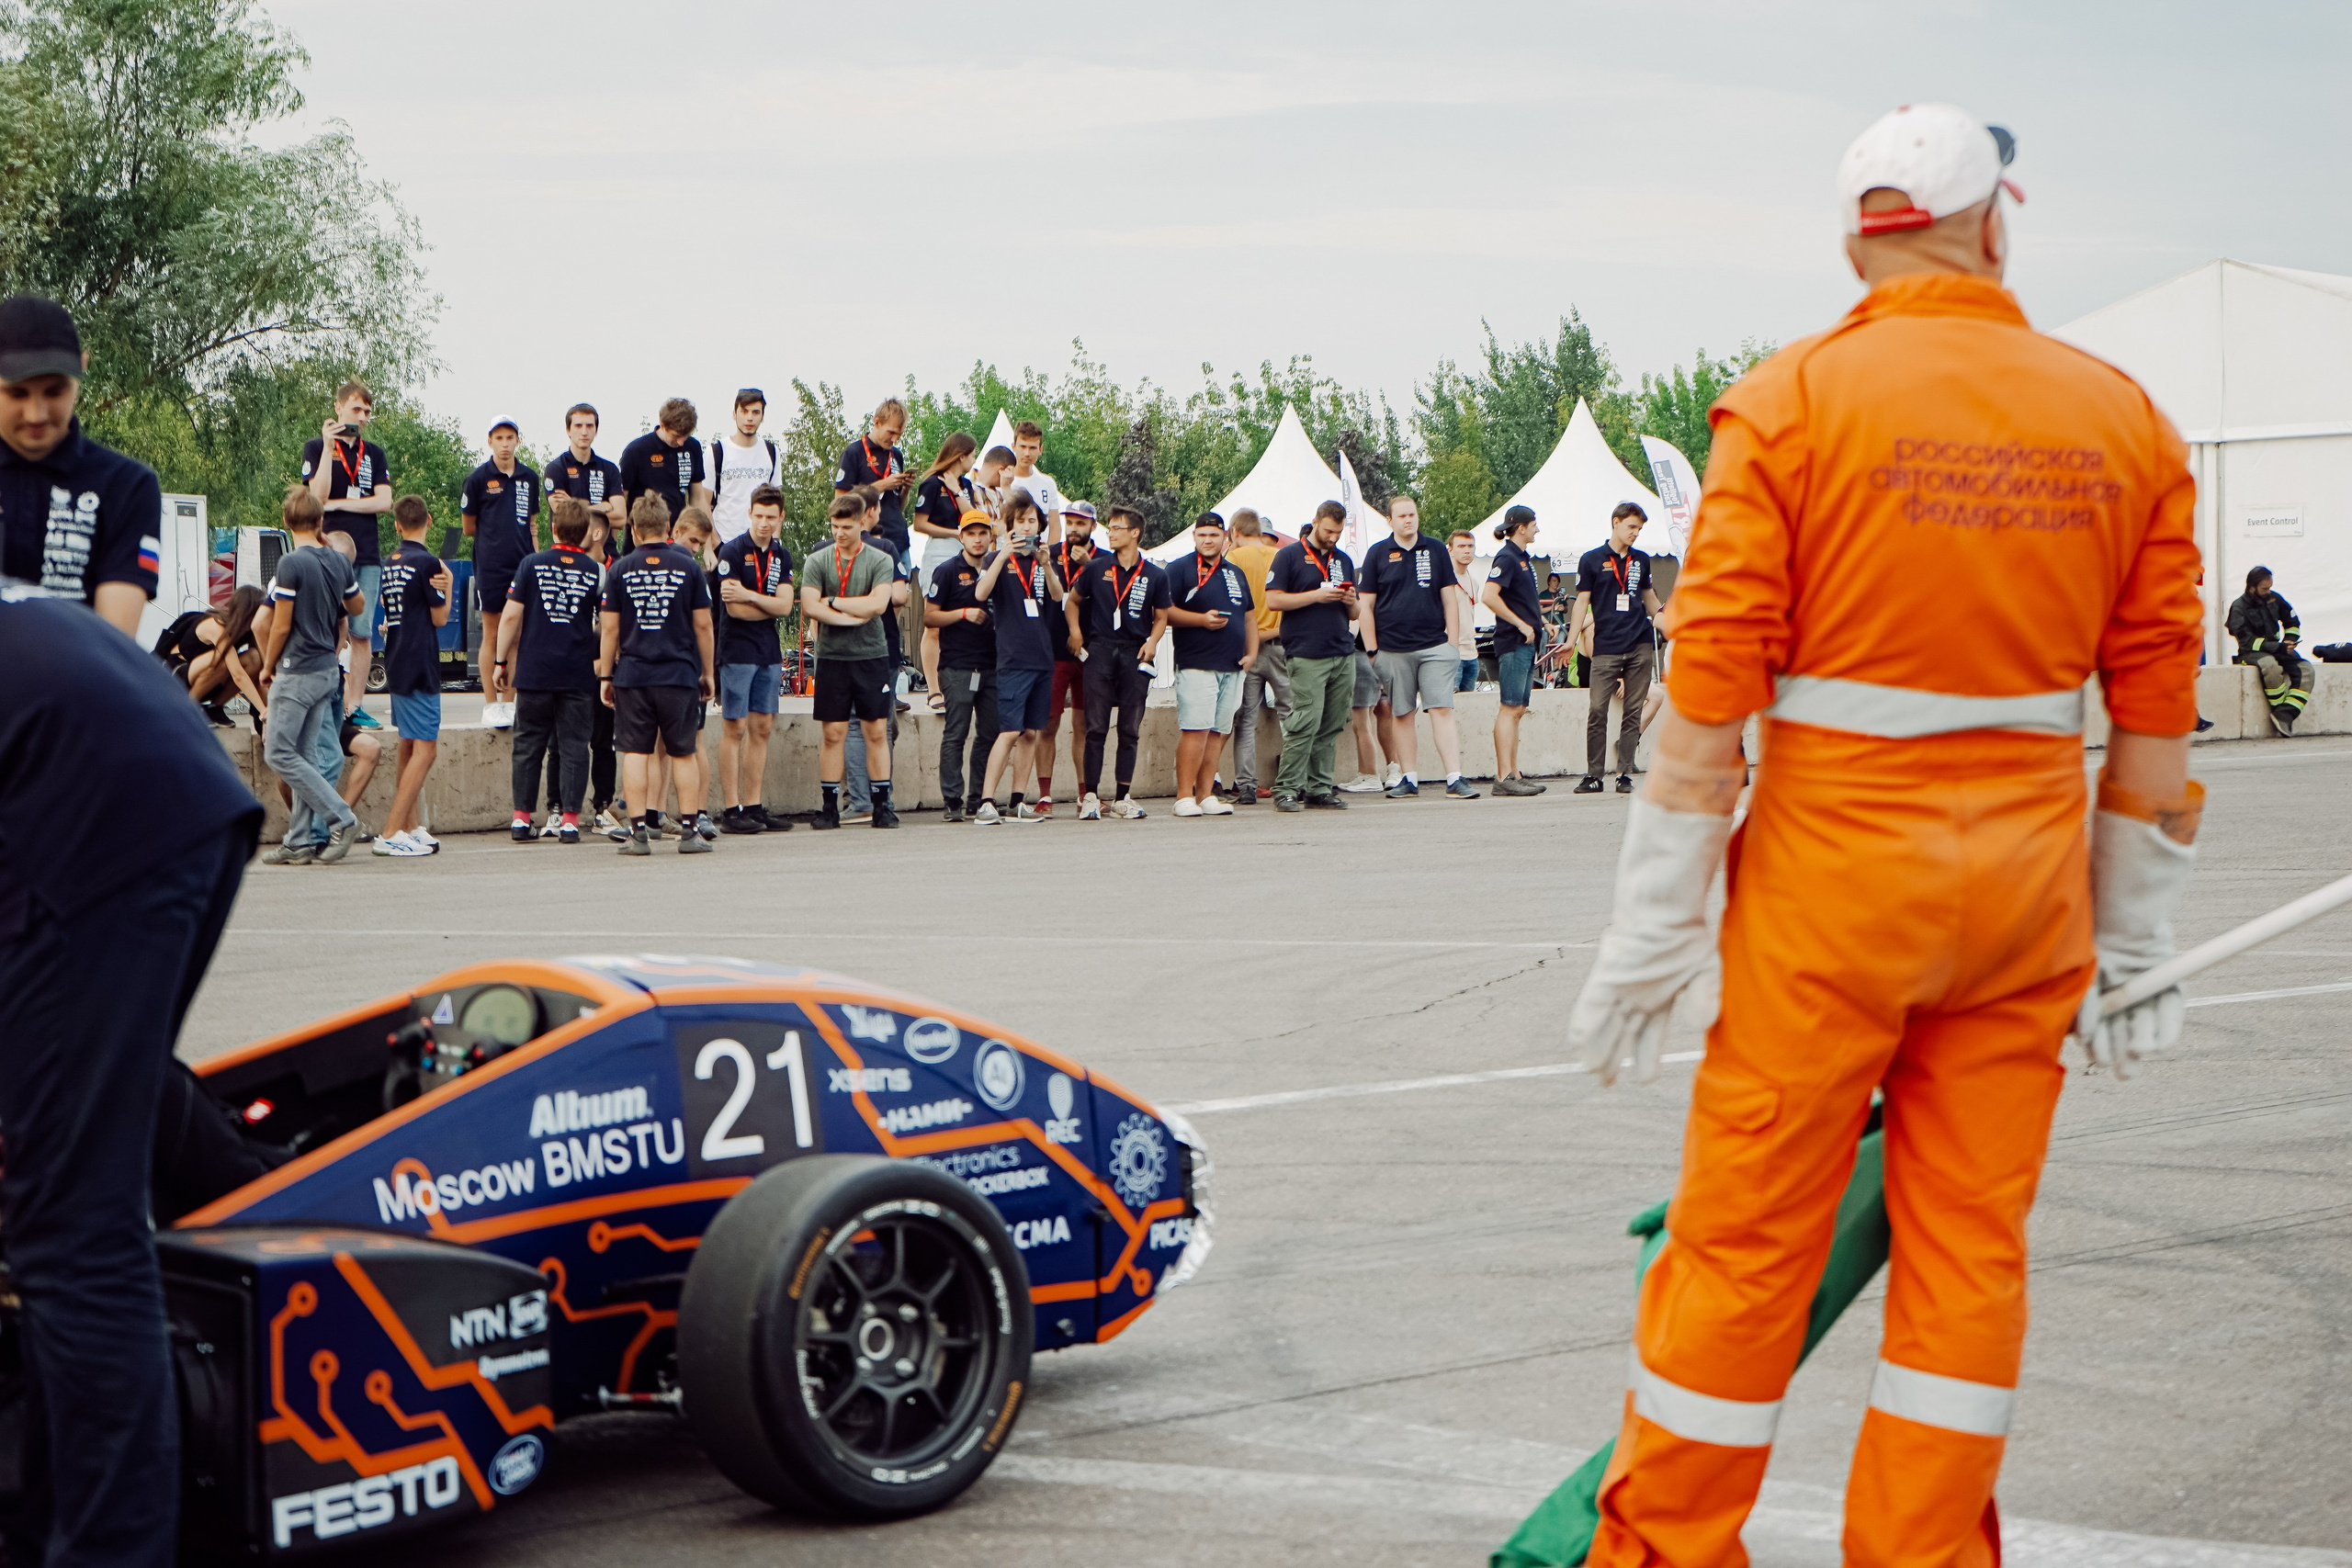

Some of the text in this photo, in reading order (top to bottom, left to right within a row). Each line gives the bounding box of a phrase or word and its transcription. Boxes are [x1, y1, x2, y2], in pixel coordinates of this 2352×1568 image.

[2247, 516, 2299, 526] Event Control
[694, 1030, 814, 1162] 21
[372, 1117, 685, 1224] Moscow BMSTU
[449, 1303, 506, 1349] NTN
[272, 1455, 459, 1549] FESTO
